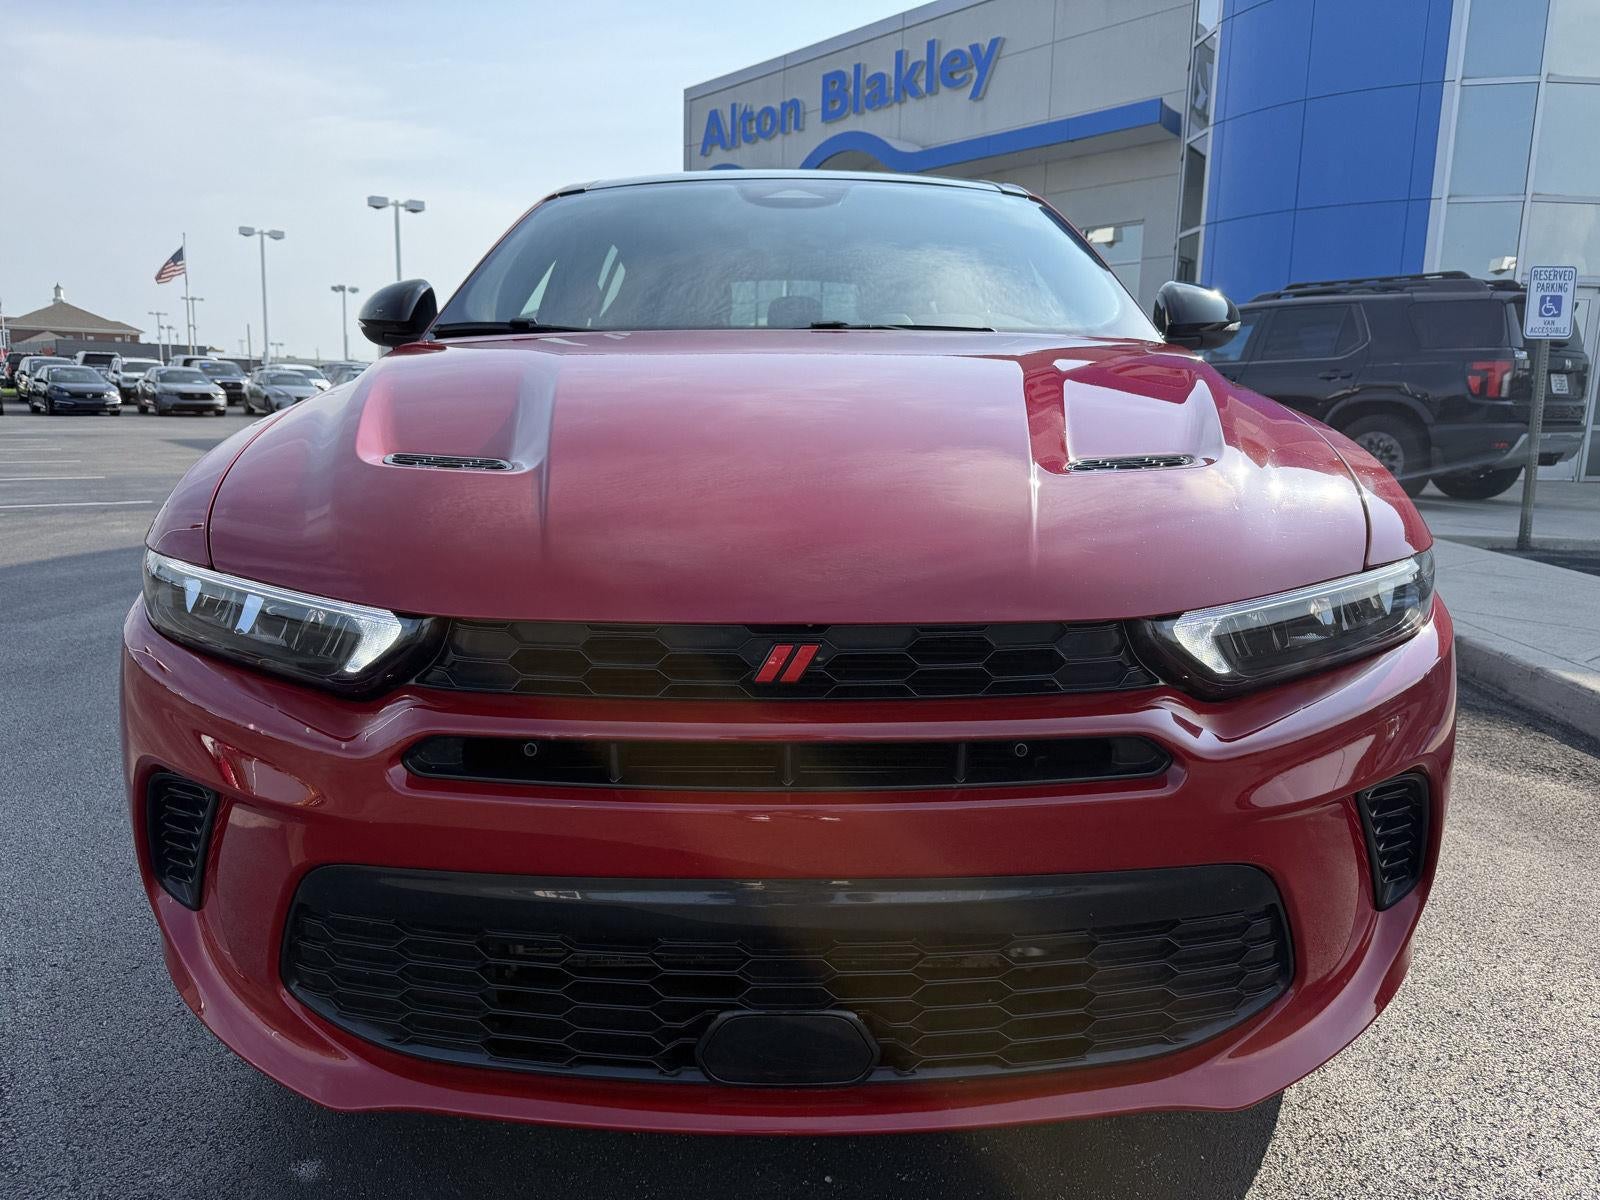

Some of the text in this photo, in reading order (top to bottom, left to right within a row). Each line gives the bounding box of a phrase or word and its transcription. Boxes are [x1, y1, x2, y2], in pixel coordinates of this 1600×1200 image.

[701, 36, 1005, 156] Alton Blakley
[1533, 269, 1574, 281] RESERVED
[1536, 282, 1568, 293] PARKING
[1530, 326, 1567, 334] ACCESSIBLE
